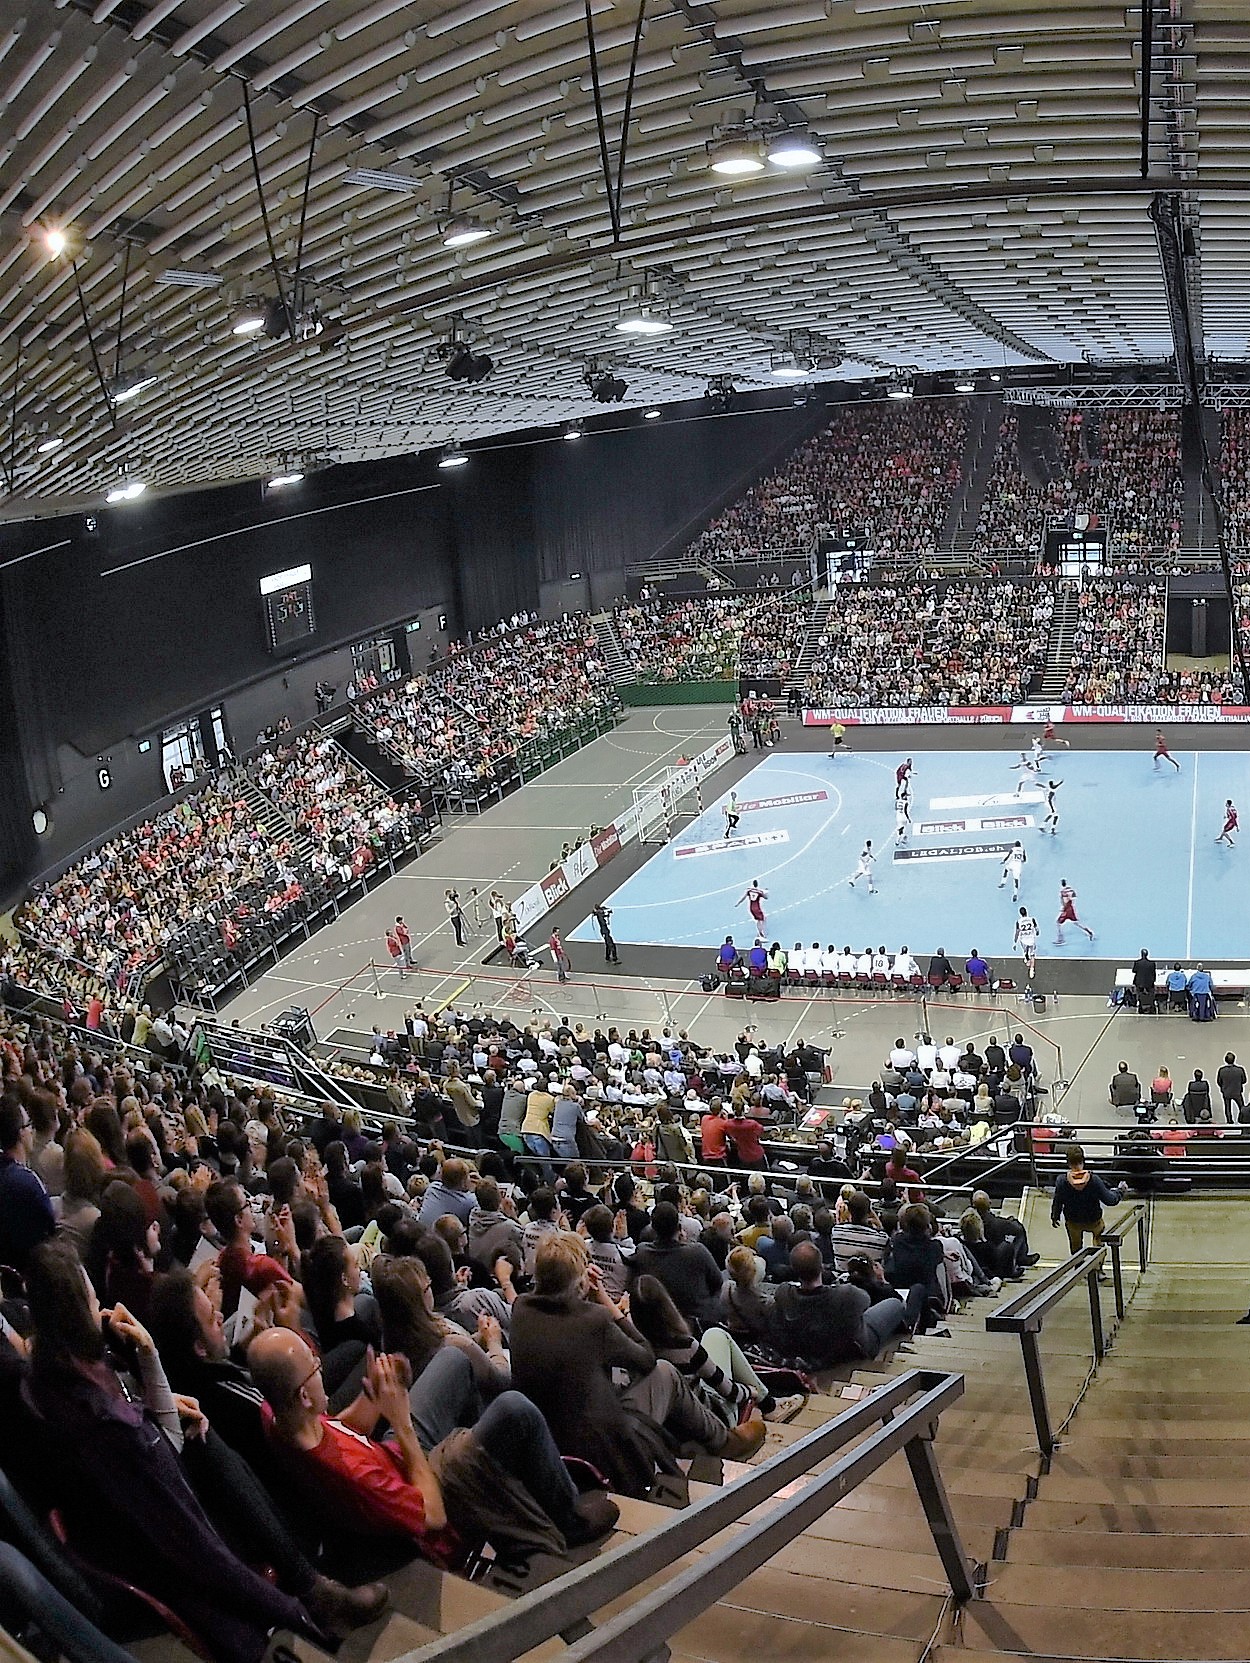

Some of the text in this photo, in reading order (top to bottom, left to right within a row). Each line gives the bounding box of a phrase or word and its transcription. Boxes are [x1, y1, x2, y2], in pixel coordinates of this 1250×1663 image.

[440, 615, 446, 630] F
[909, 706, 947, 718] FRAUEN
[1178, 706, 1221, 718] FRAUEN
[99, 769, 110, 788] G
[544, 878, 569, 905] Blick
[1021, 923, 1032, 931] 22
